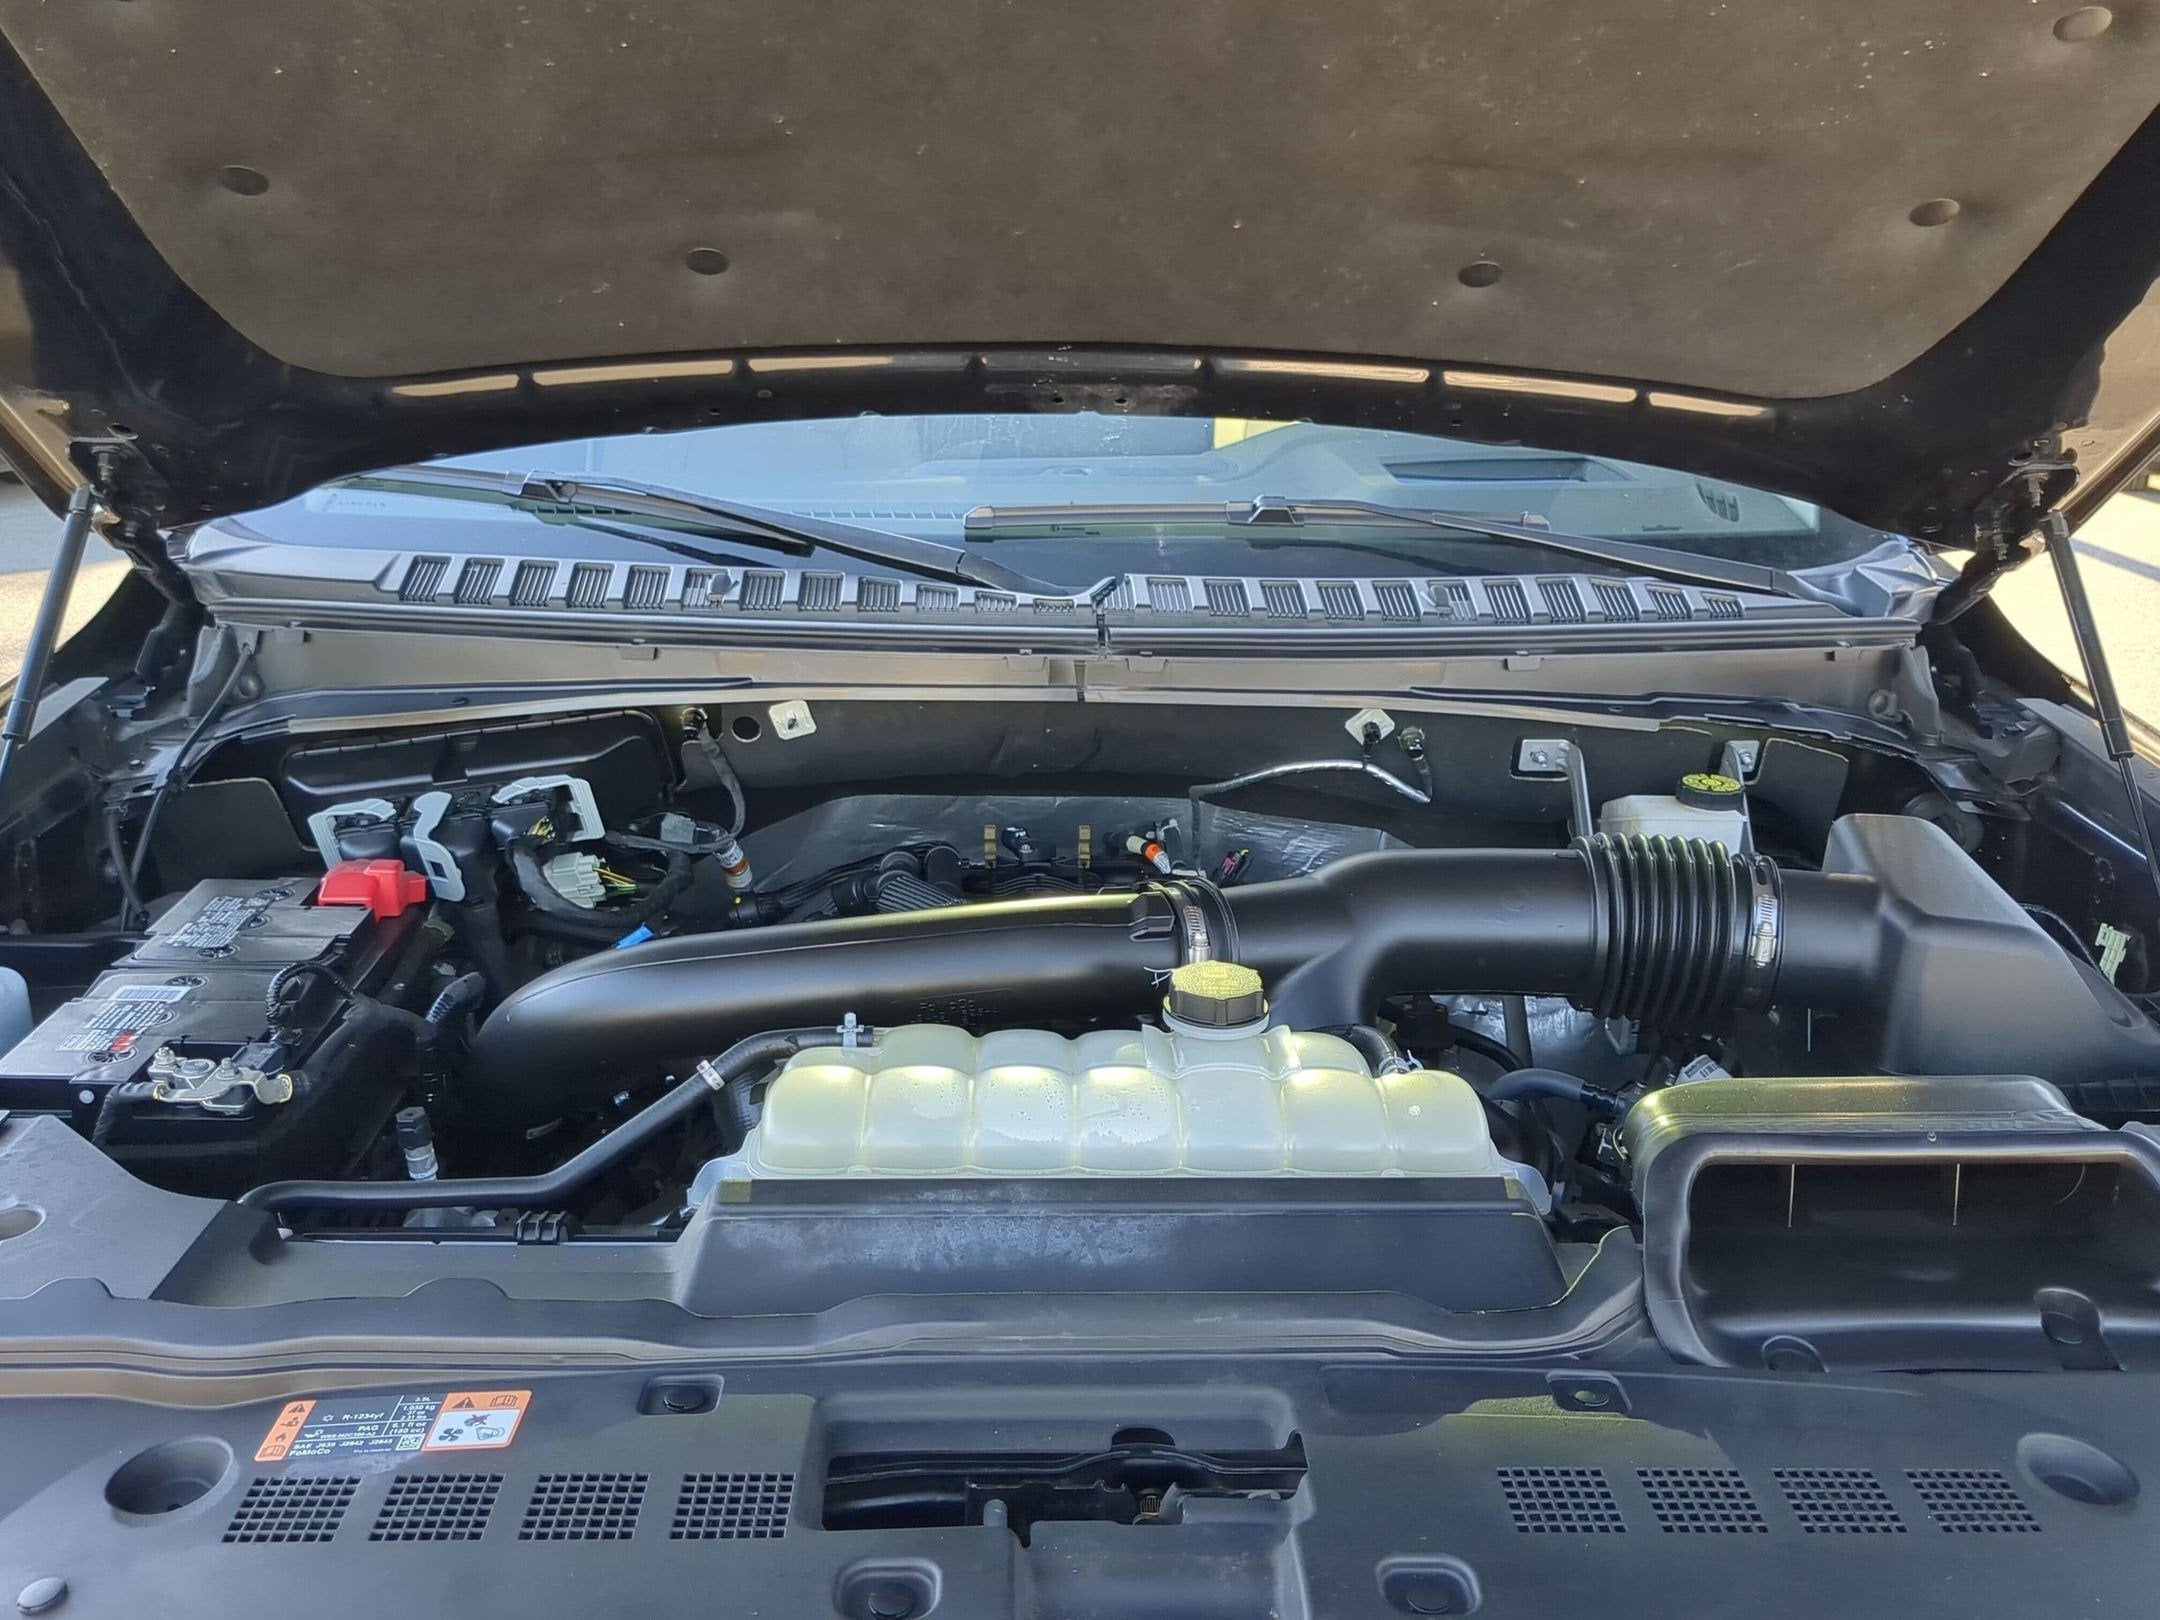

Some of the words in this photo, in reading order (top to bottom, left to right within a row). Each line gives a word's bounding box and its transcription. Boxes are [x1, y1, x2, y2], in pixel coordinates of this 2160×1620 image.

[342, 1412, 385, 1421] R-1234yf
[357, 1424, 380, 1432] PAG
[288, 1448, 332, 1457] FoMoCo
